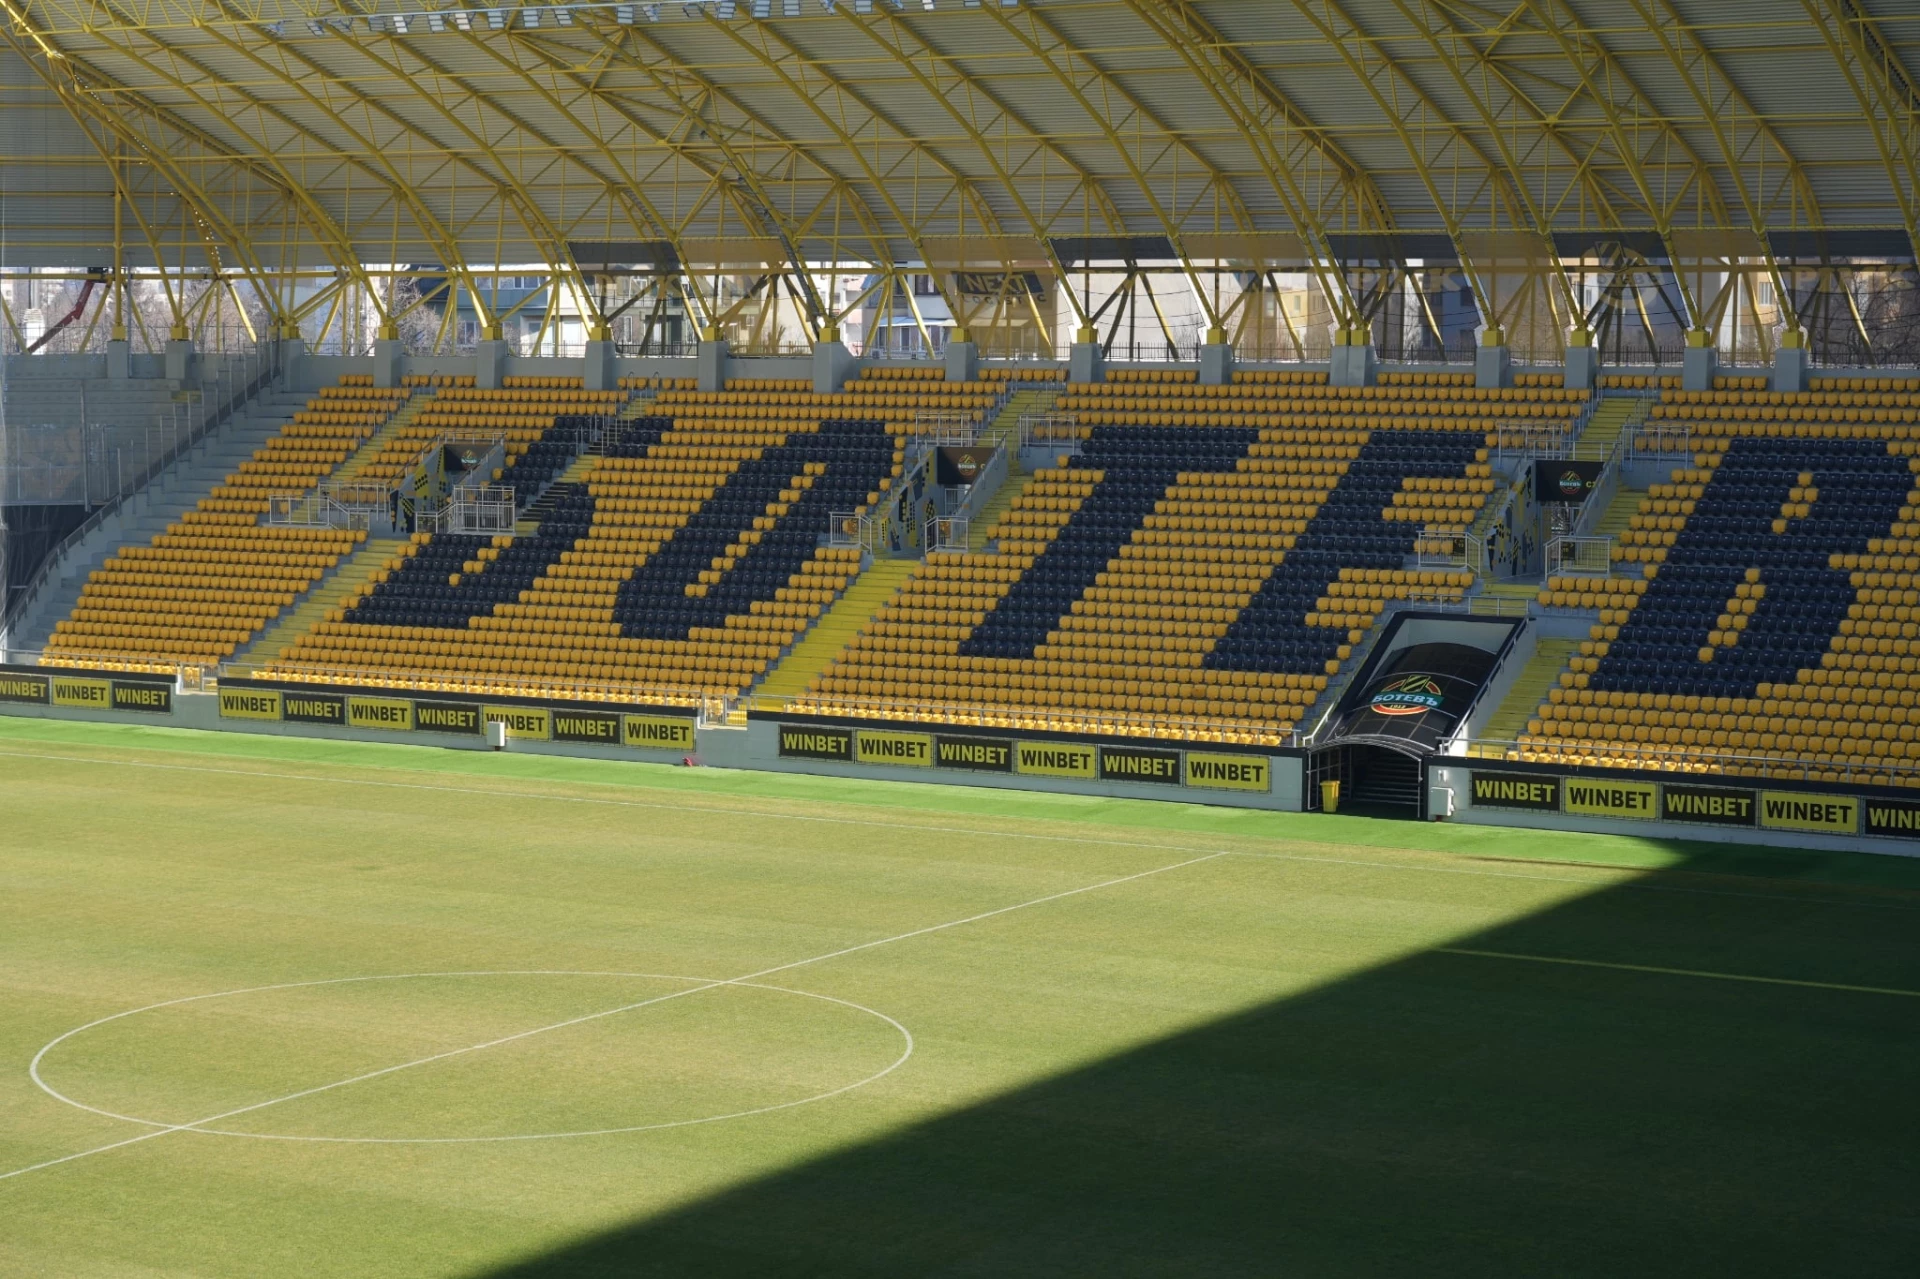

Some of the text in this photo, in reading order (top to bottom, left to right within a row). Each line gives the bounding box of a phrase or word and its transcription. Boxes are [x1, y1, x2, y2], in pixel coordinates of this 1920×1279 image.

[55, 686, 106, 702] WINBET
[115, 688, 168, 706] WINBET
[222, 695, 277, 713] WINBET
[1371, 694, 1438, 706] БОТЕВЪ
[285, 699, 342, 718] WINBET
[351, 704, 408, 723] WINBET
[417, 708, 476, 727] WINBET
[556, 718, 617, 737] WINBET
[627, 723, 689, 741] WINBET
[782, 733, 848, 753] WINBET
[860, 738, 928, 758] WINBET
[939, 743, 1008, 764] WINBET
[1020, 749, 1091, 770] WINBET
[1103, 755, 1176, 777] WINBET
[1190, 761, 1264, 783] WINBET
[1475, 779, 1555, 803] WINBET
[1569, 787, 1652, 810] WINBET
[1666, 793, 1751, 817] WINBET
[1766, 800, 1853, 824] WINBET
